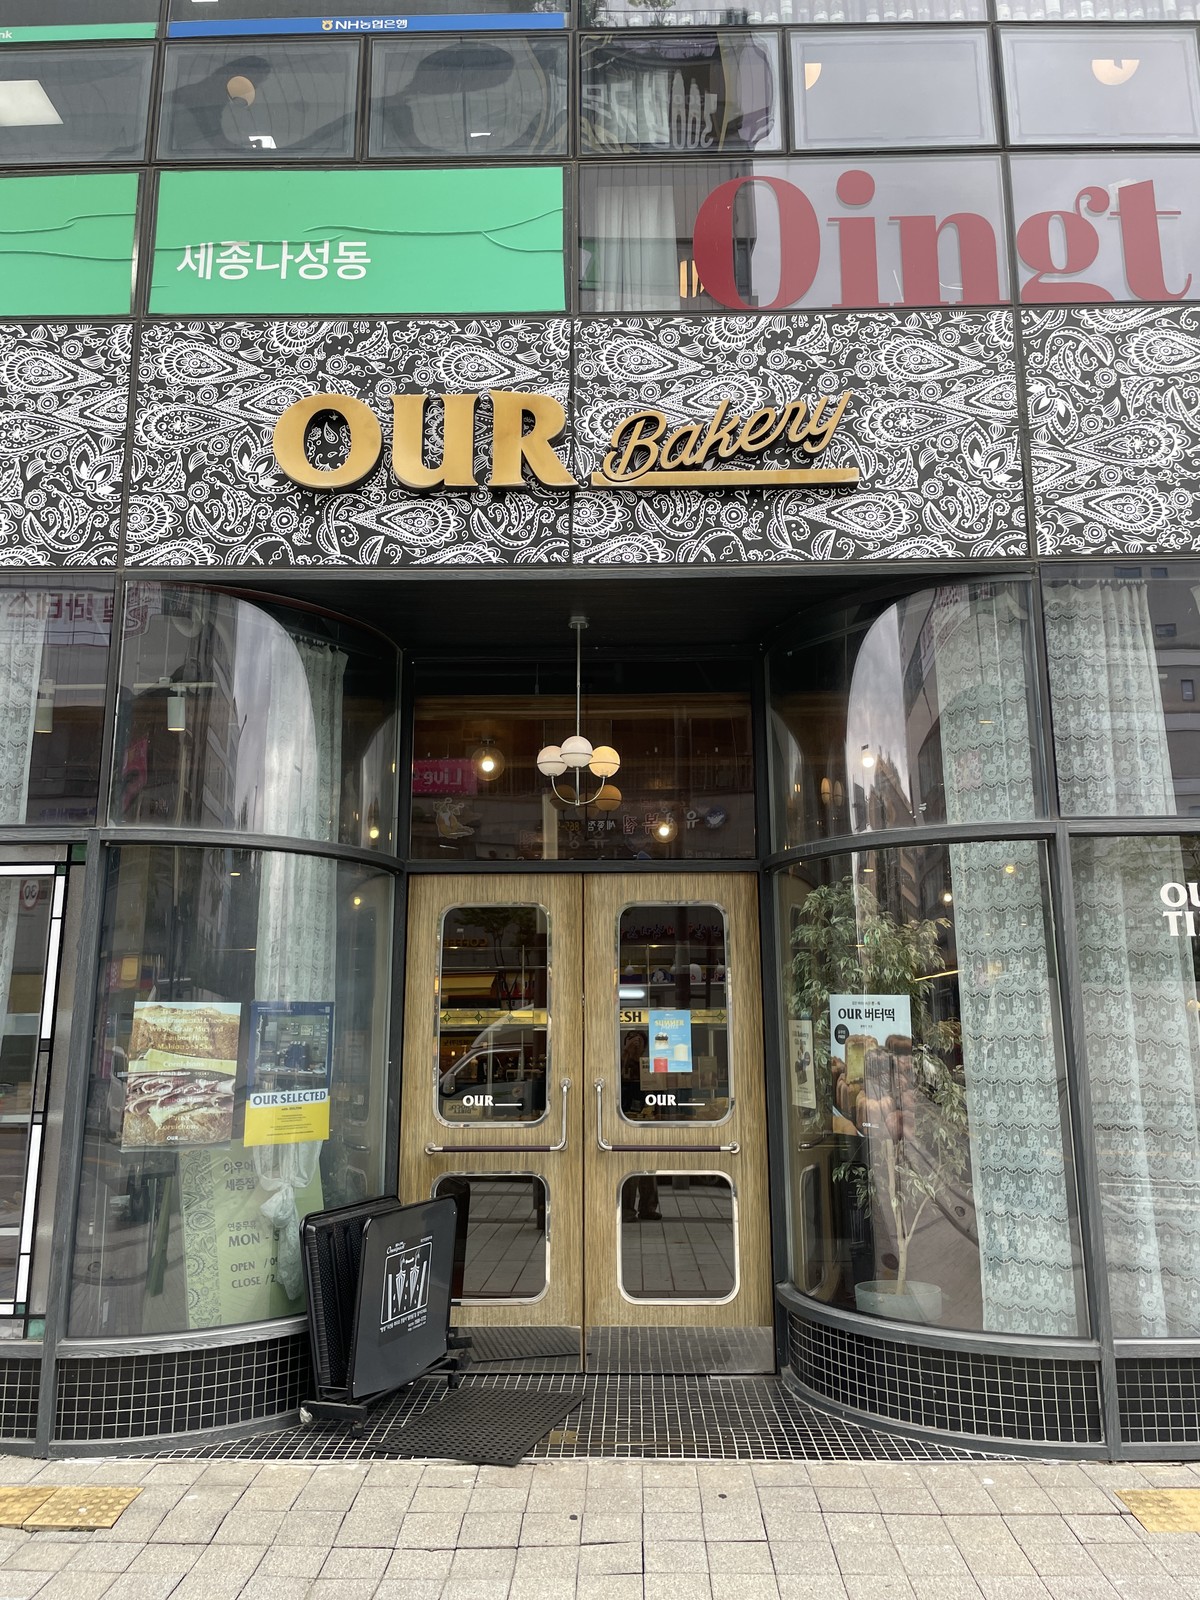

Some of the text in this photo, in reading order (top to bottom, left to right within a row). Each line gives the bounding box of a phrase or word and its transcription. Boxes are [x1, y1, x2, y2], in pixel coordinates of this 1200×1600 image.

[335, 18, 408, 30] NH농협은행
[692, 169, 1193, 310] Oingt
[176, 240, 372, 281] 세종나성동
[273, 389, 852, 490] OUR Bakery
[838, 1008, 895, 1022] OUR 버터떡
[253, 1090, 326, 1105] OUR SELECTED
[462, 1095, 494, 1106] OUR
[645, 1094, 677, 1106] OUR
[225, 1177, 256, 1191] 세종점
[228, 1232, 260, 1247] MON
[230, 1261, 255, 1272] OPEN
[231, 1276, 261, 1288] CLOSE
